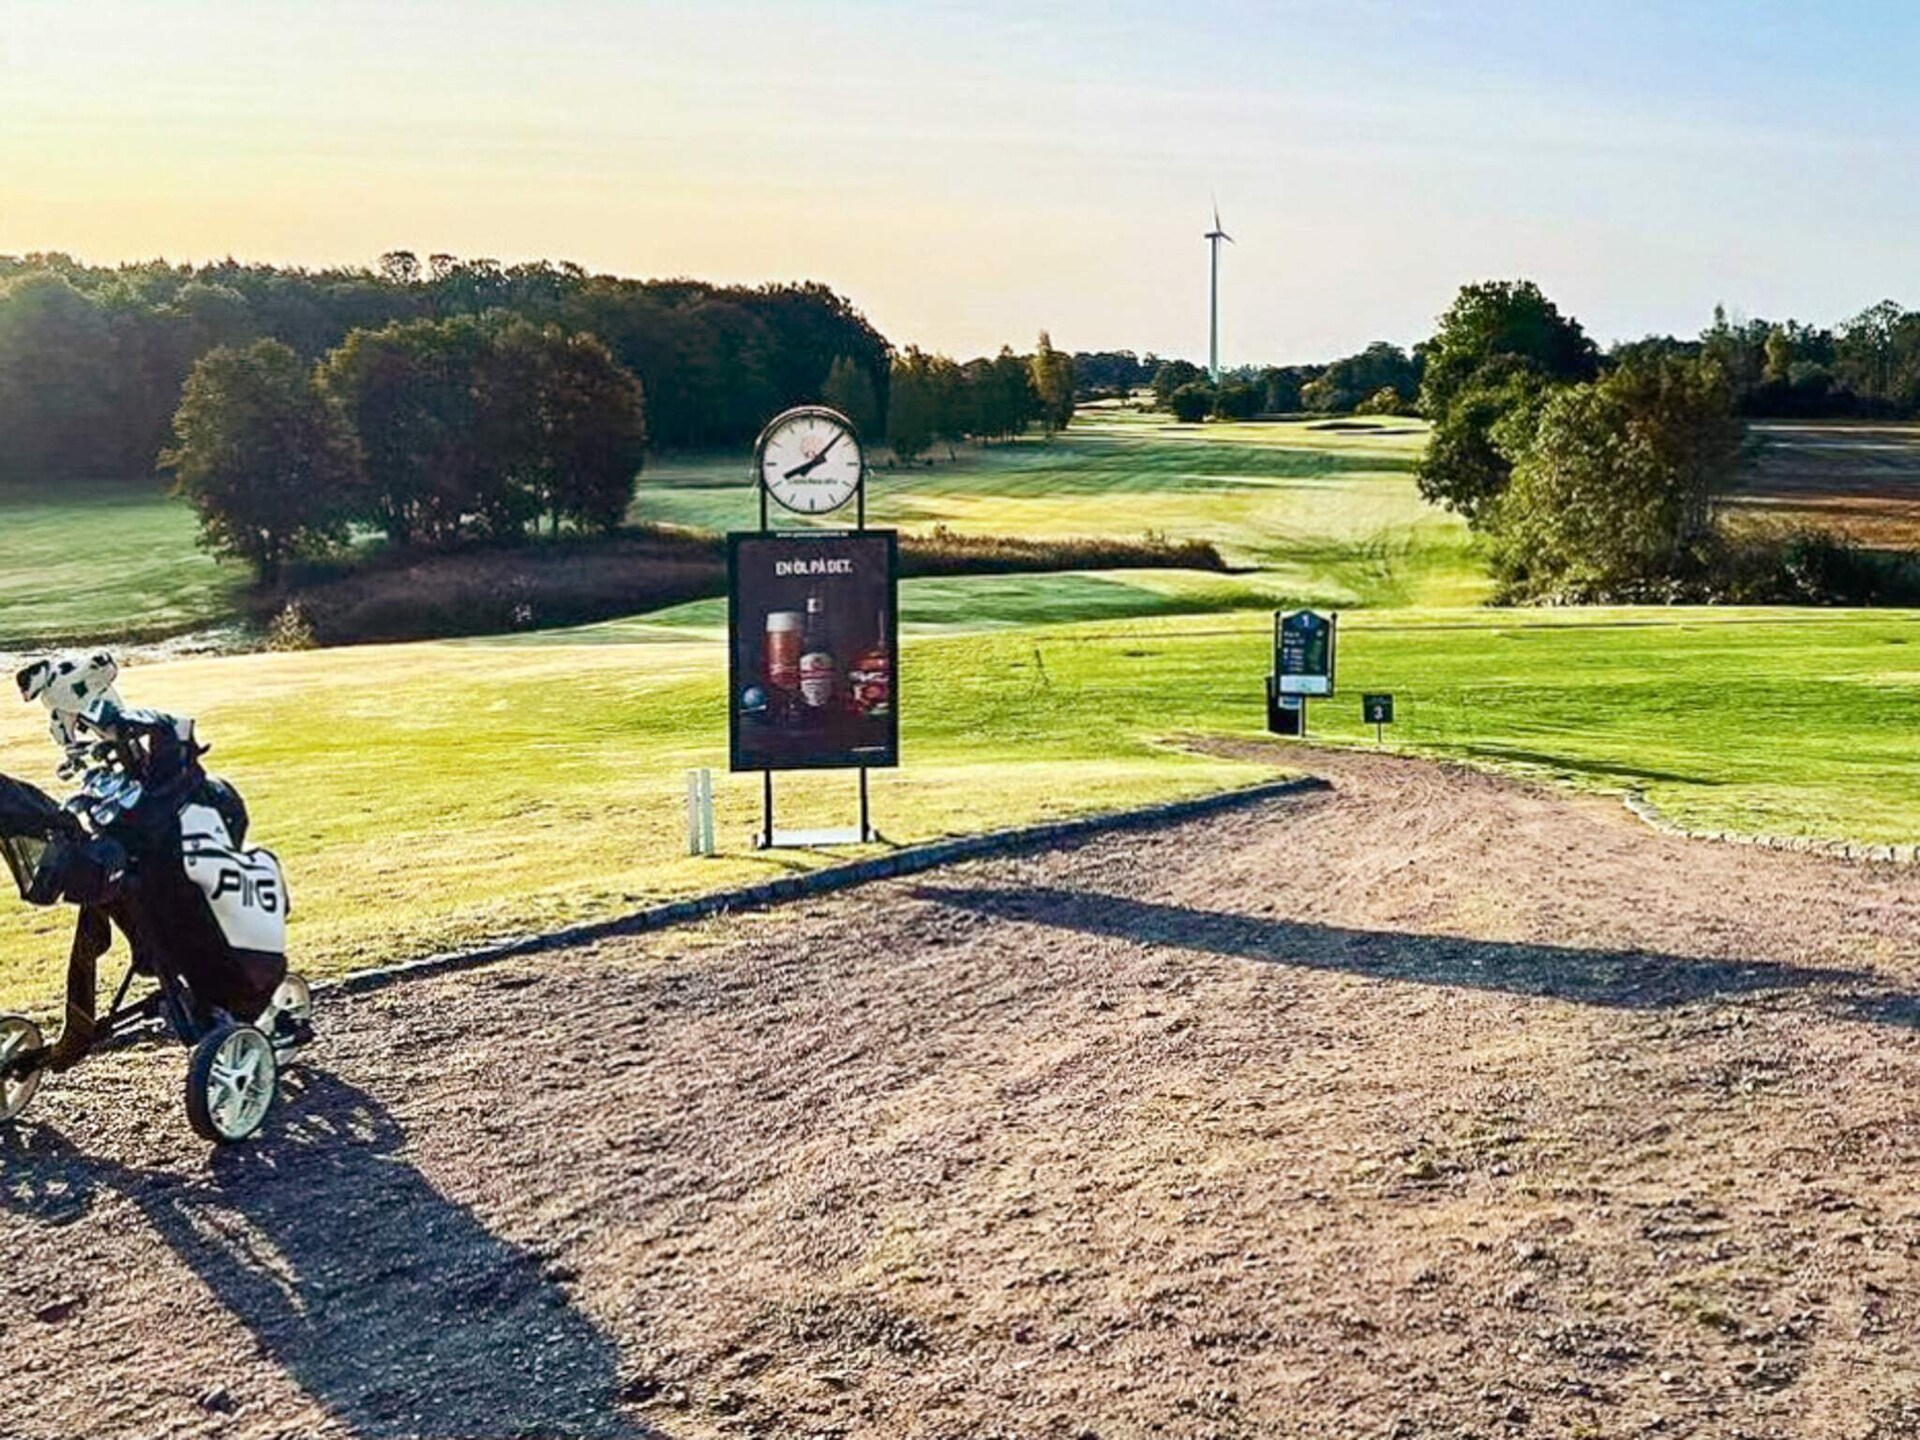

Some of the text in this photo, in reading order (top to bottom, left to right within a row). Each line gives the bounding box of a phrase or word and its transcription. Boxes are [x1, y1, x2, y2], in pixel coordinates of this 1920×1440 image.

[775, 560, 793, 576] EN
[827, 558, 853, 574] DET.
[1302, 614, 1310, 627] 1
[1373, 705, 1384, 720] 3
[210, 868, 278, 914] PING
